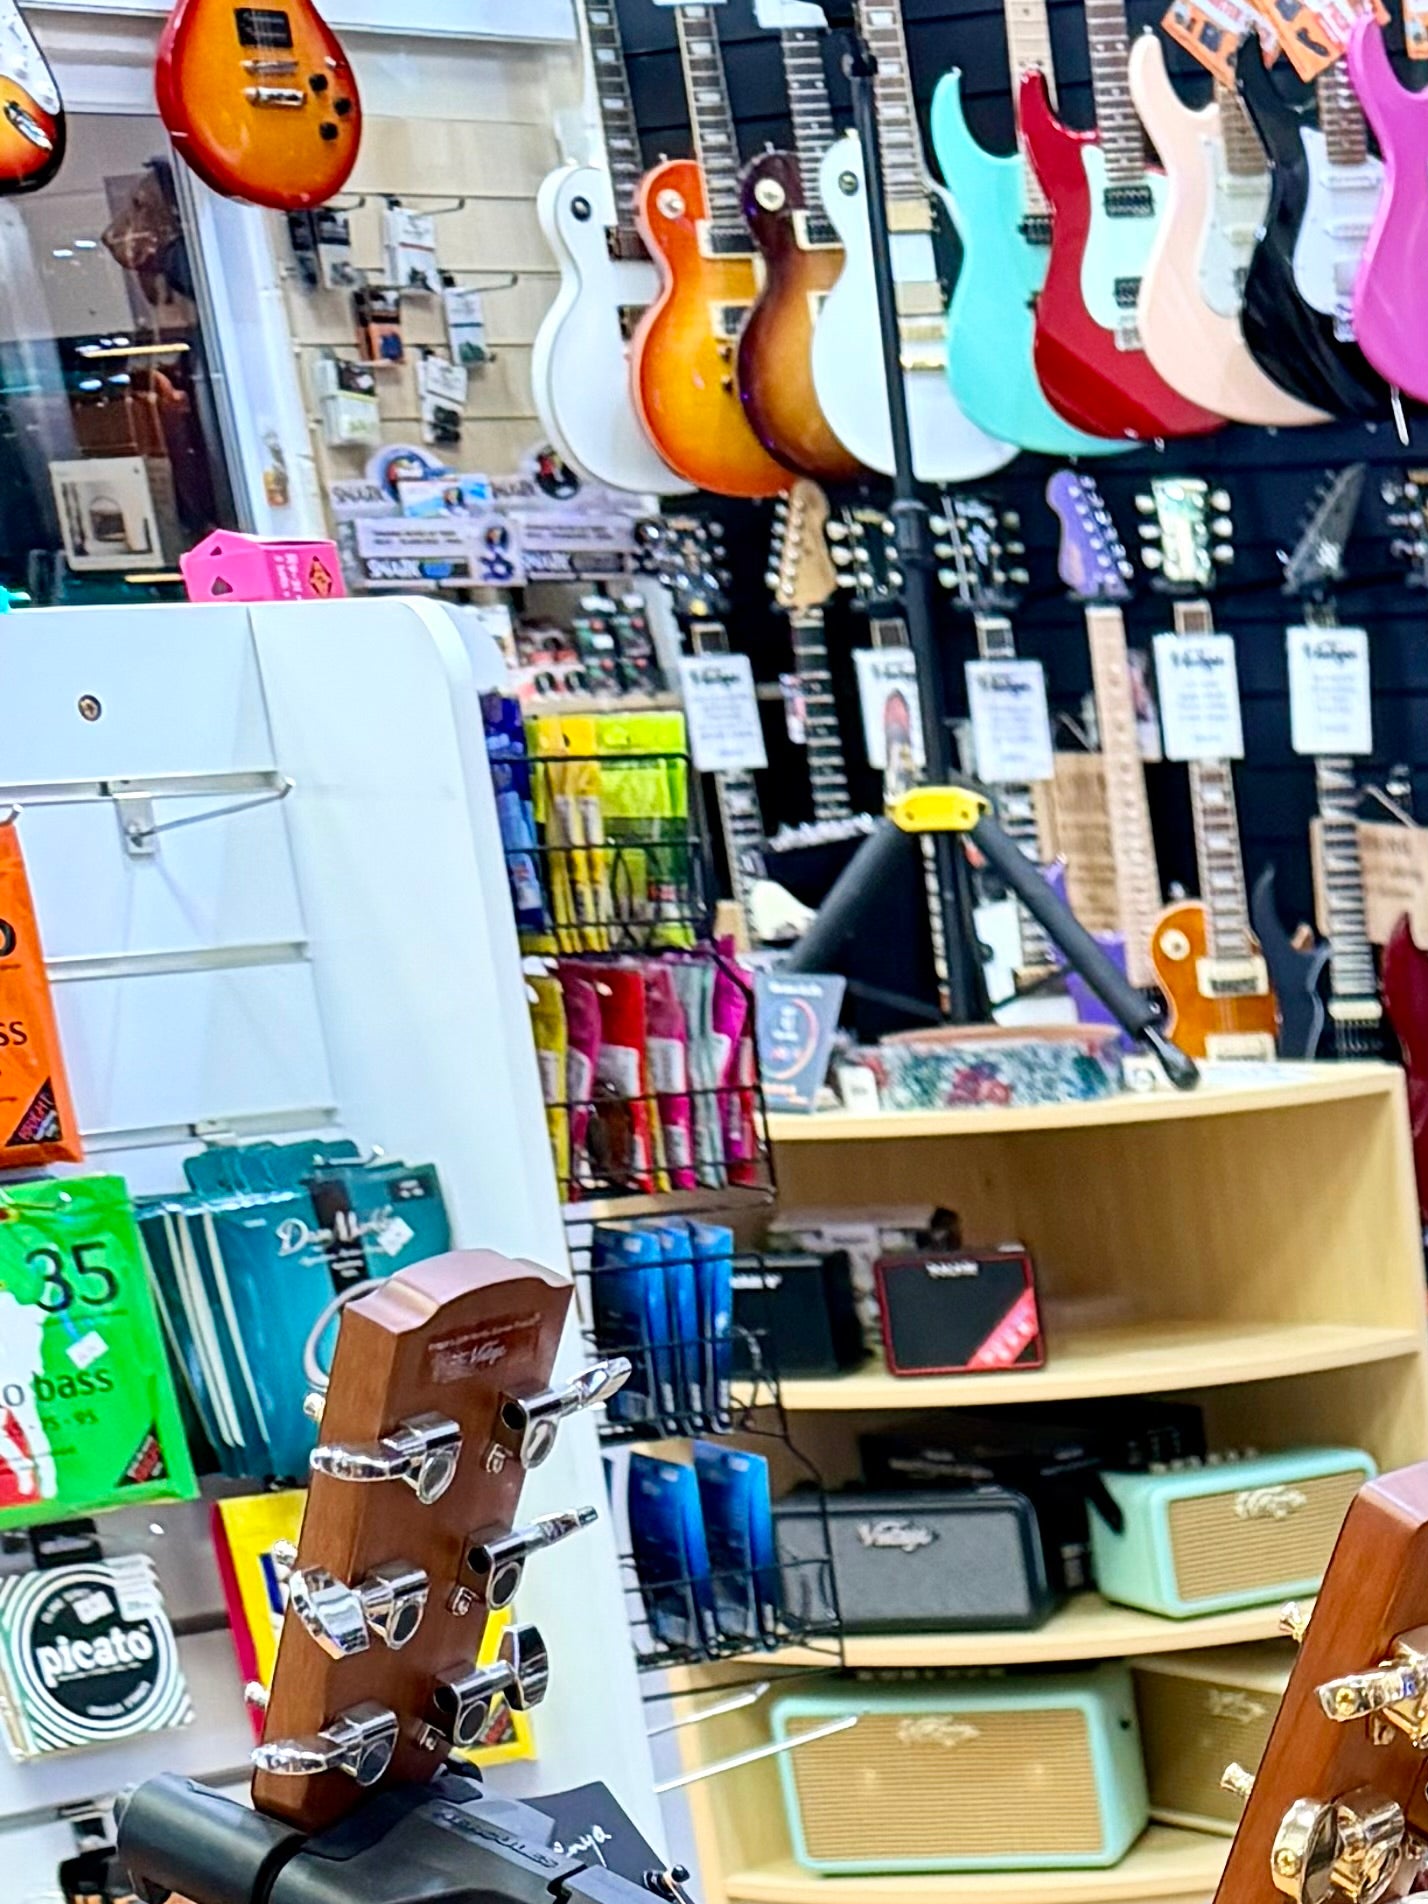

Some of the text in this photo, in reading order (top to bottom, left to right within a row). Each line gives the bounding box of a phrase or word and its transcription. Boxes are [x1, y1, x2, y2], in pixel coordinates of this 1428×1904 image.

[25, 1240, 120, 1314] 35
[33, 1370, 114, 1402] bass
[36, 1625, 154, 1689] picato
[553, 1824, 613, 1869] nya
